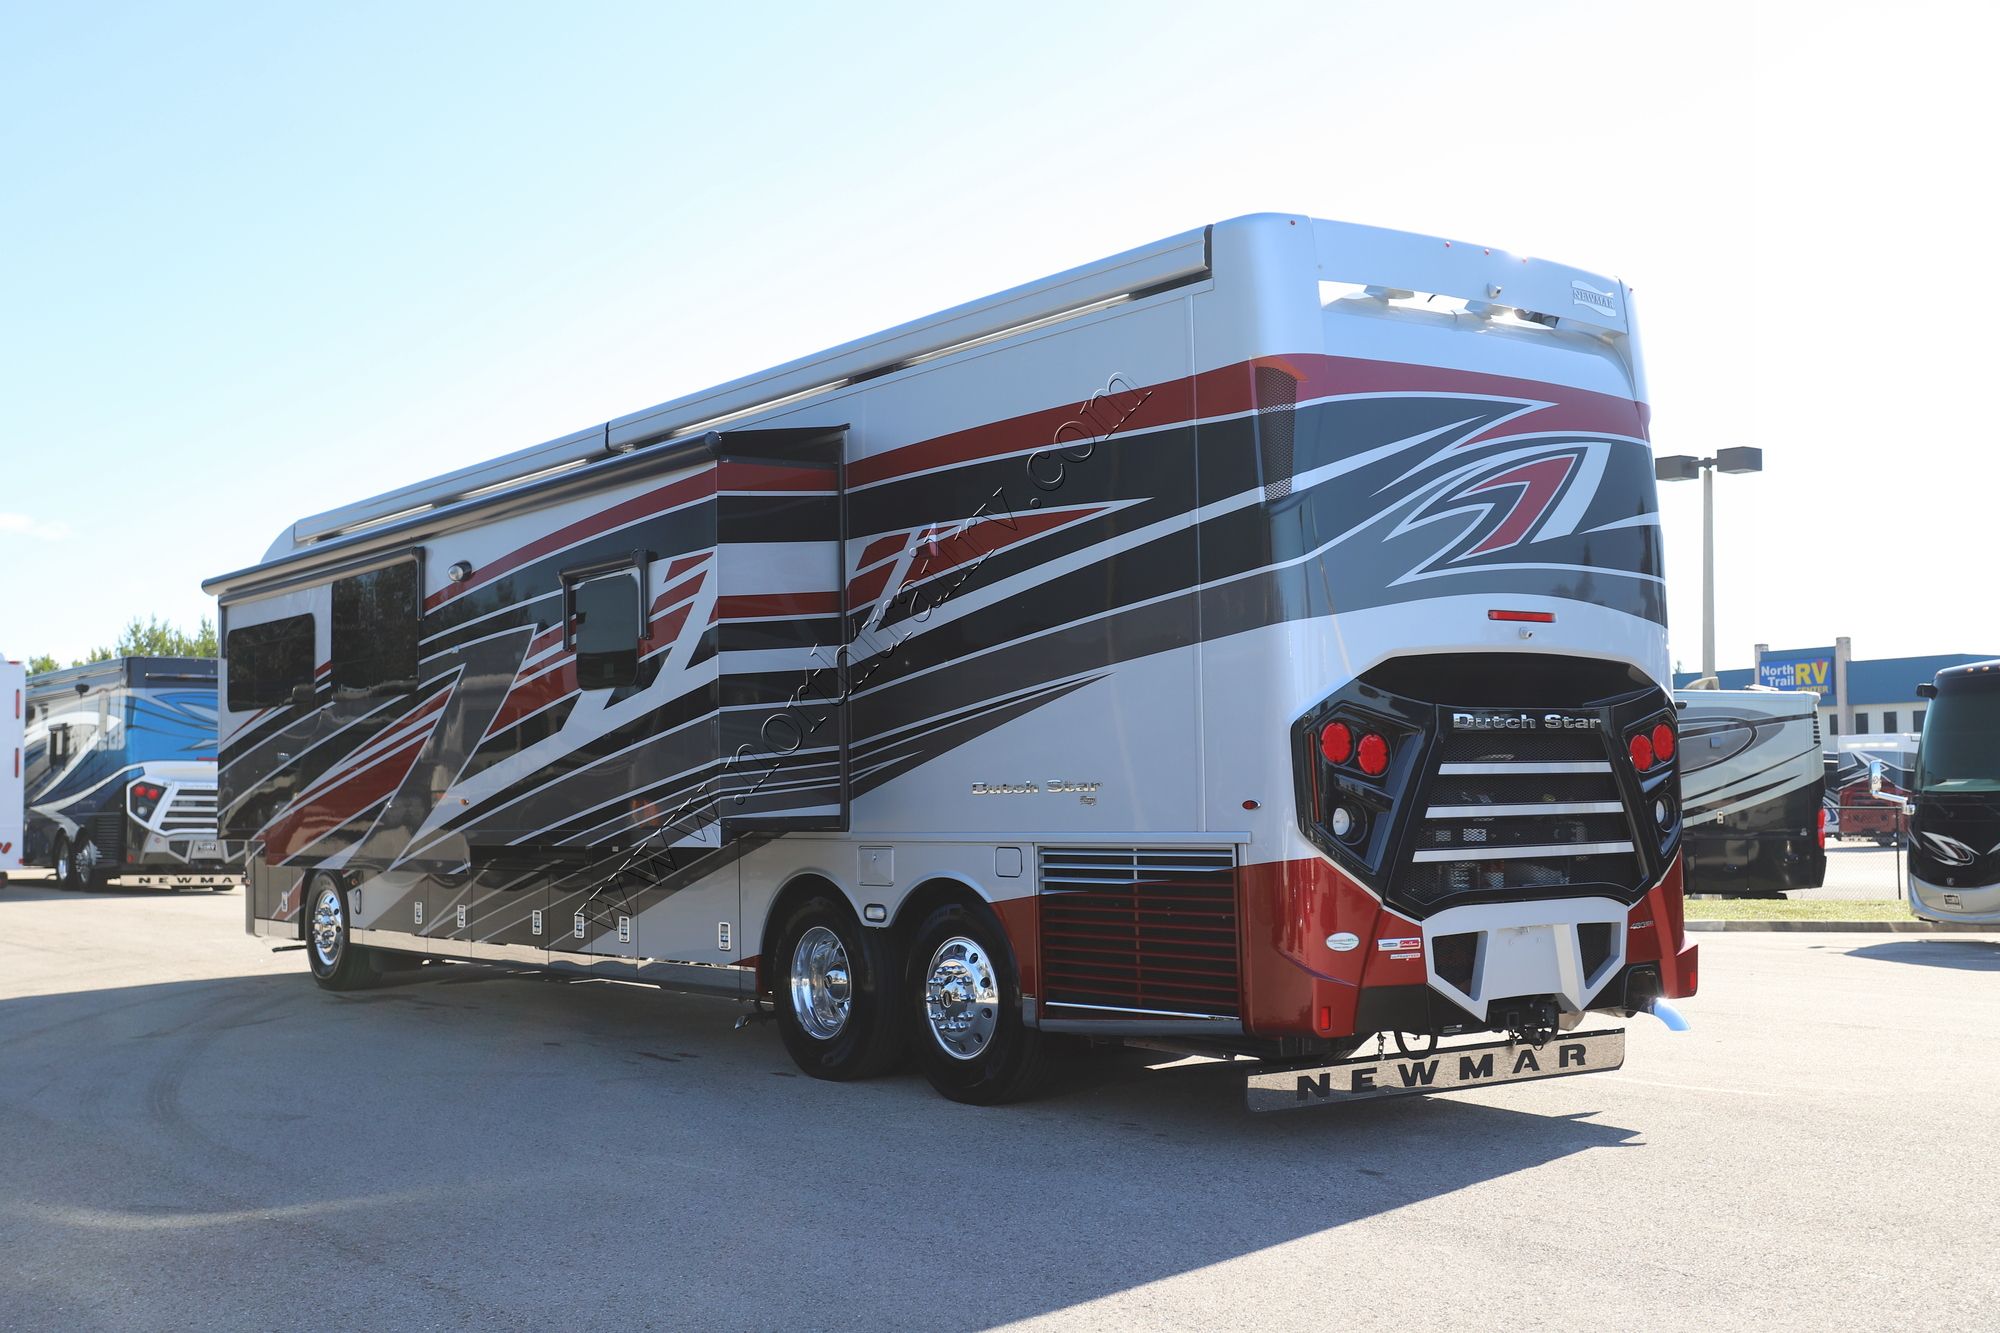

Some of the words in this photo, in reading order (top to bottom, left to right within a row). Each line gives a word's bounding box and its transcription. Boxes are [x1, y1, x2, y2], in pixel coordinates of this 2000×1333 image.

[1572, 289, 1616, 310] NEWMAR
[1761, 665, 1794, 676] North
[1795, 662, 1829, 685] RV
[1768, 675, 1794, 686] Trail
[1453, 713, 1536, 729] Dutch
[1544, 713, 1602, 729] Star
[972, 780, 1039, 795] Dutch
[1047, 779, 1102, 793] Star
[1297, 1043, 1586, 1100] NEWMAR
